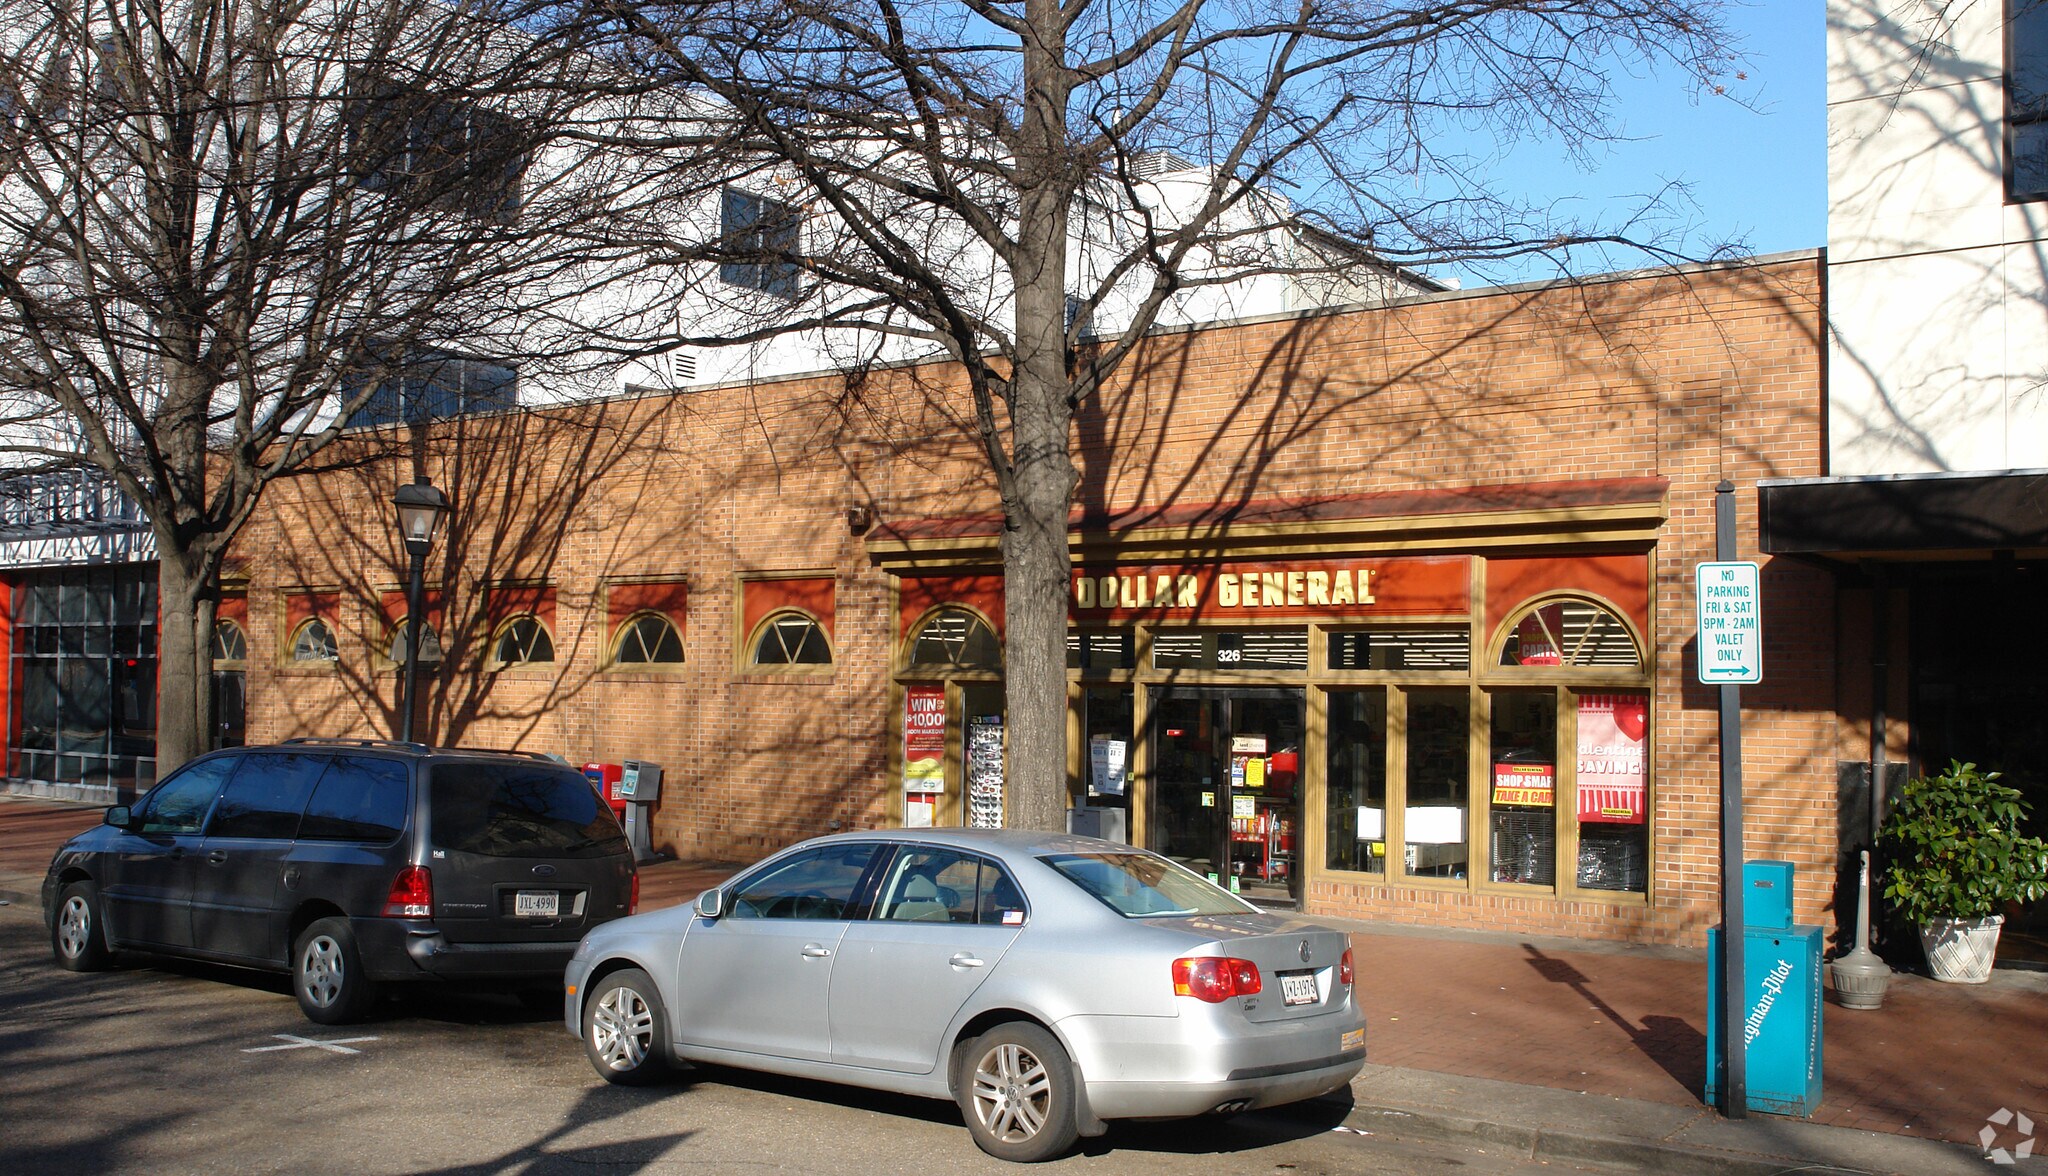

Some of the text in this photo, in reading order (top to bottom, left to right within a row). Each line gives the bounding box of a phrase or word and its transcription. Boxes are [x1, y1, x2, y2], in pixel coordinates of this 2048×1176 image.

[1721, 570, 1735, 582] NO
[1077, 569, 1376, 609] DOLLAR GENERAL
[1707, 586, 1750, 598] PARKING
[1705, 602, 1752, 614] FRI & SAT
[1703, 617, 1725, 630] 9PM
[1733, 617, 1755, 630] 2AM
[1715, 633, 1744, 645] VALET
[1217, 649, 1241, 662] 326
[1717, 649, 1742, 661] ONLY
[911, 698, 936, 712] WIN
[1578, 743, 1647, 757] alentine
[1496, 774, 1553, 788] SHOP SMAR
[1495, 790, 1553, 803] TAKE A CAR
[1744, 959, 1794, 1050] rginian-Pilot
